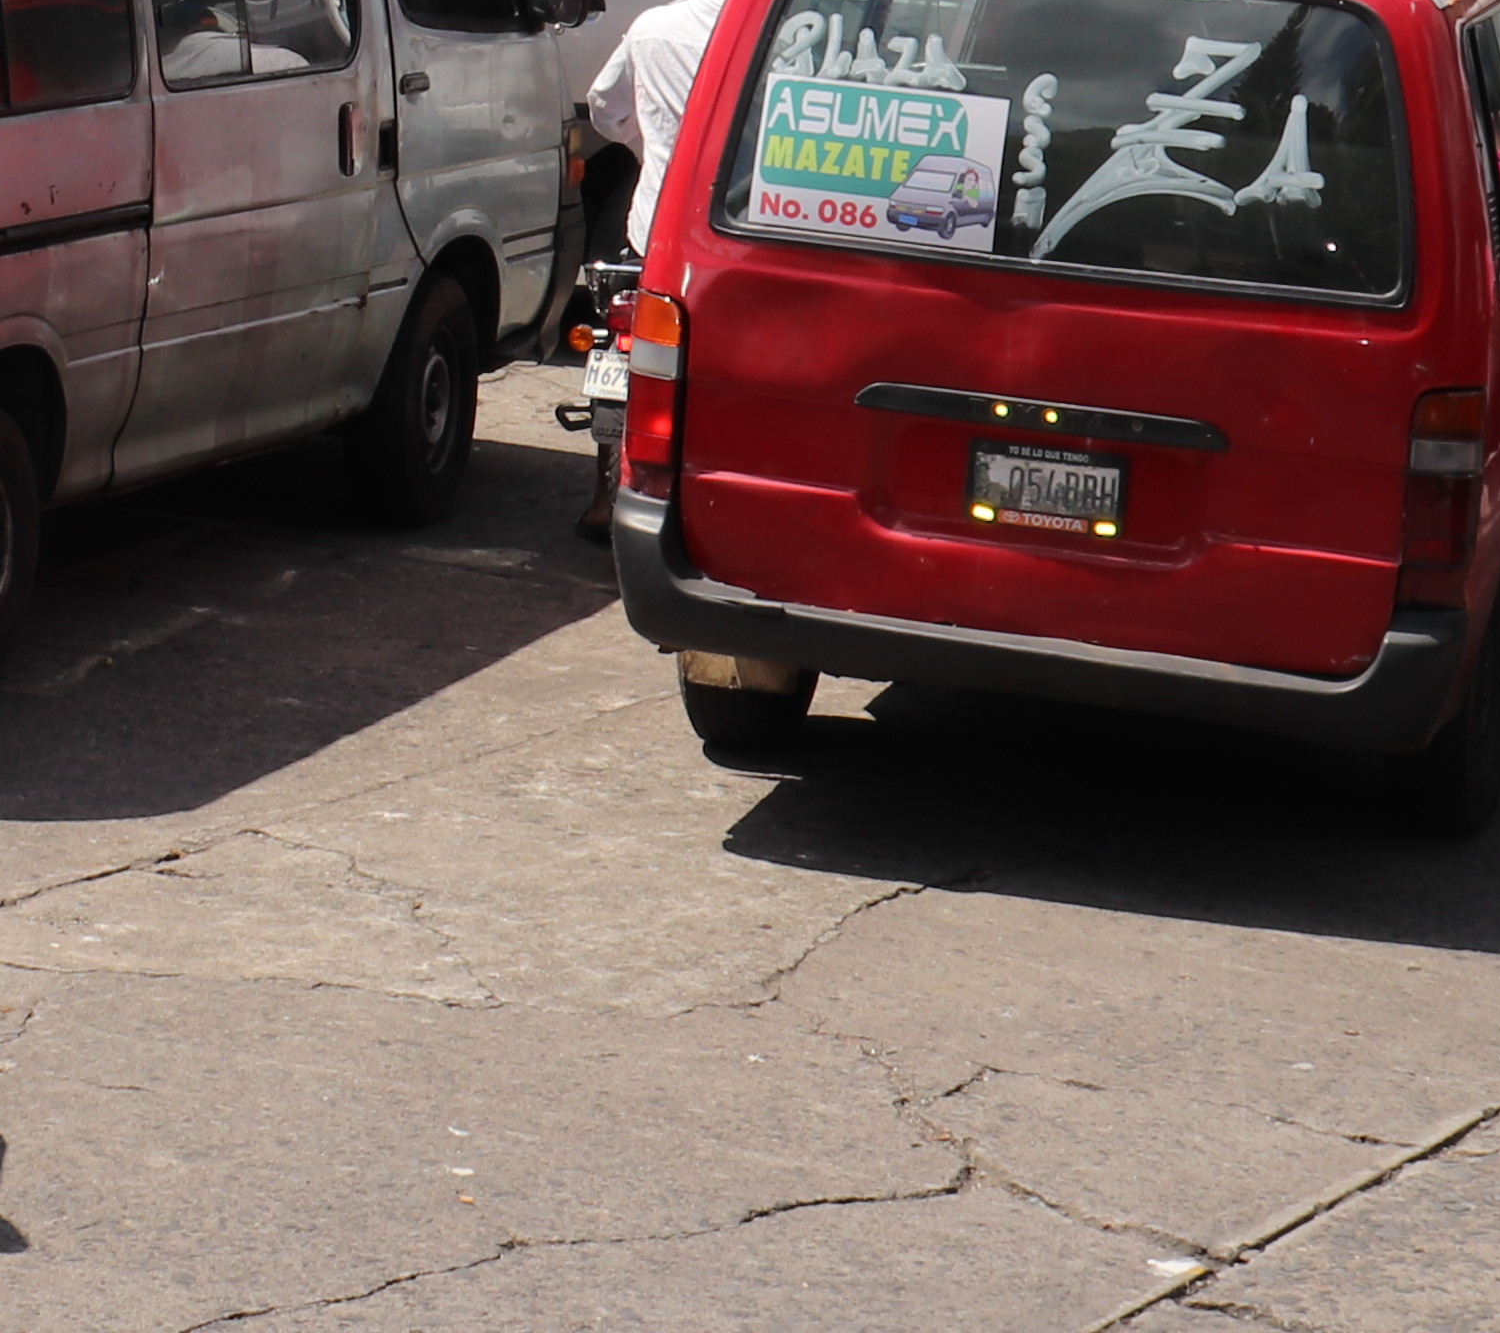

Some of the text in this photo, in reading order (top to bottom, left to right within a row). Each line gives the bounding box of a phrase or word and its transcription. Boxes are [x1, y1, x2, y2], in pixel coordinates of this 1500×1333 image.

[768, 87, 965, 150] ASUMEX
[764, 135, 911, 183] MAZATE
[760, 192, 877, 228] No. 086
[968, 398, 1110, 434] TYTA
[1009, 446, 1089, 462] YO SÉ LO QUE TENGO
[1023, 513, 1083, 531] TOYOTA
